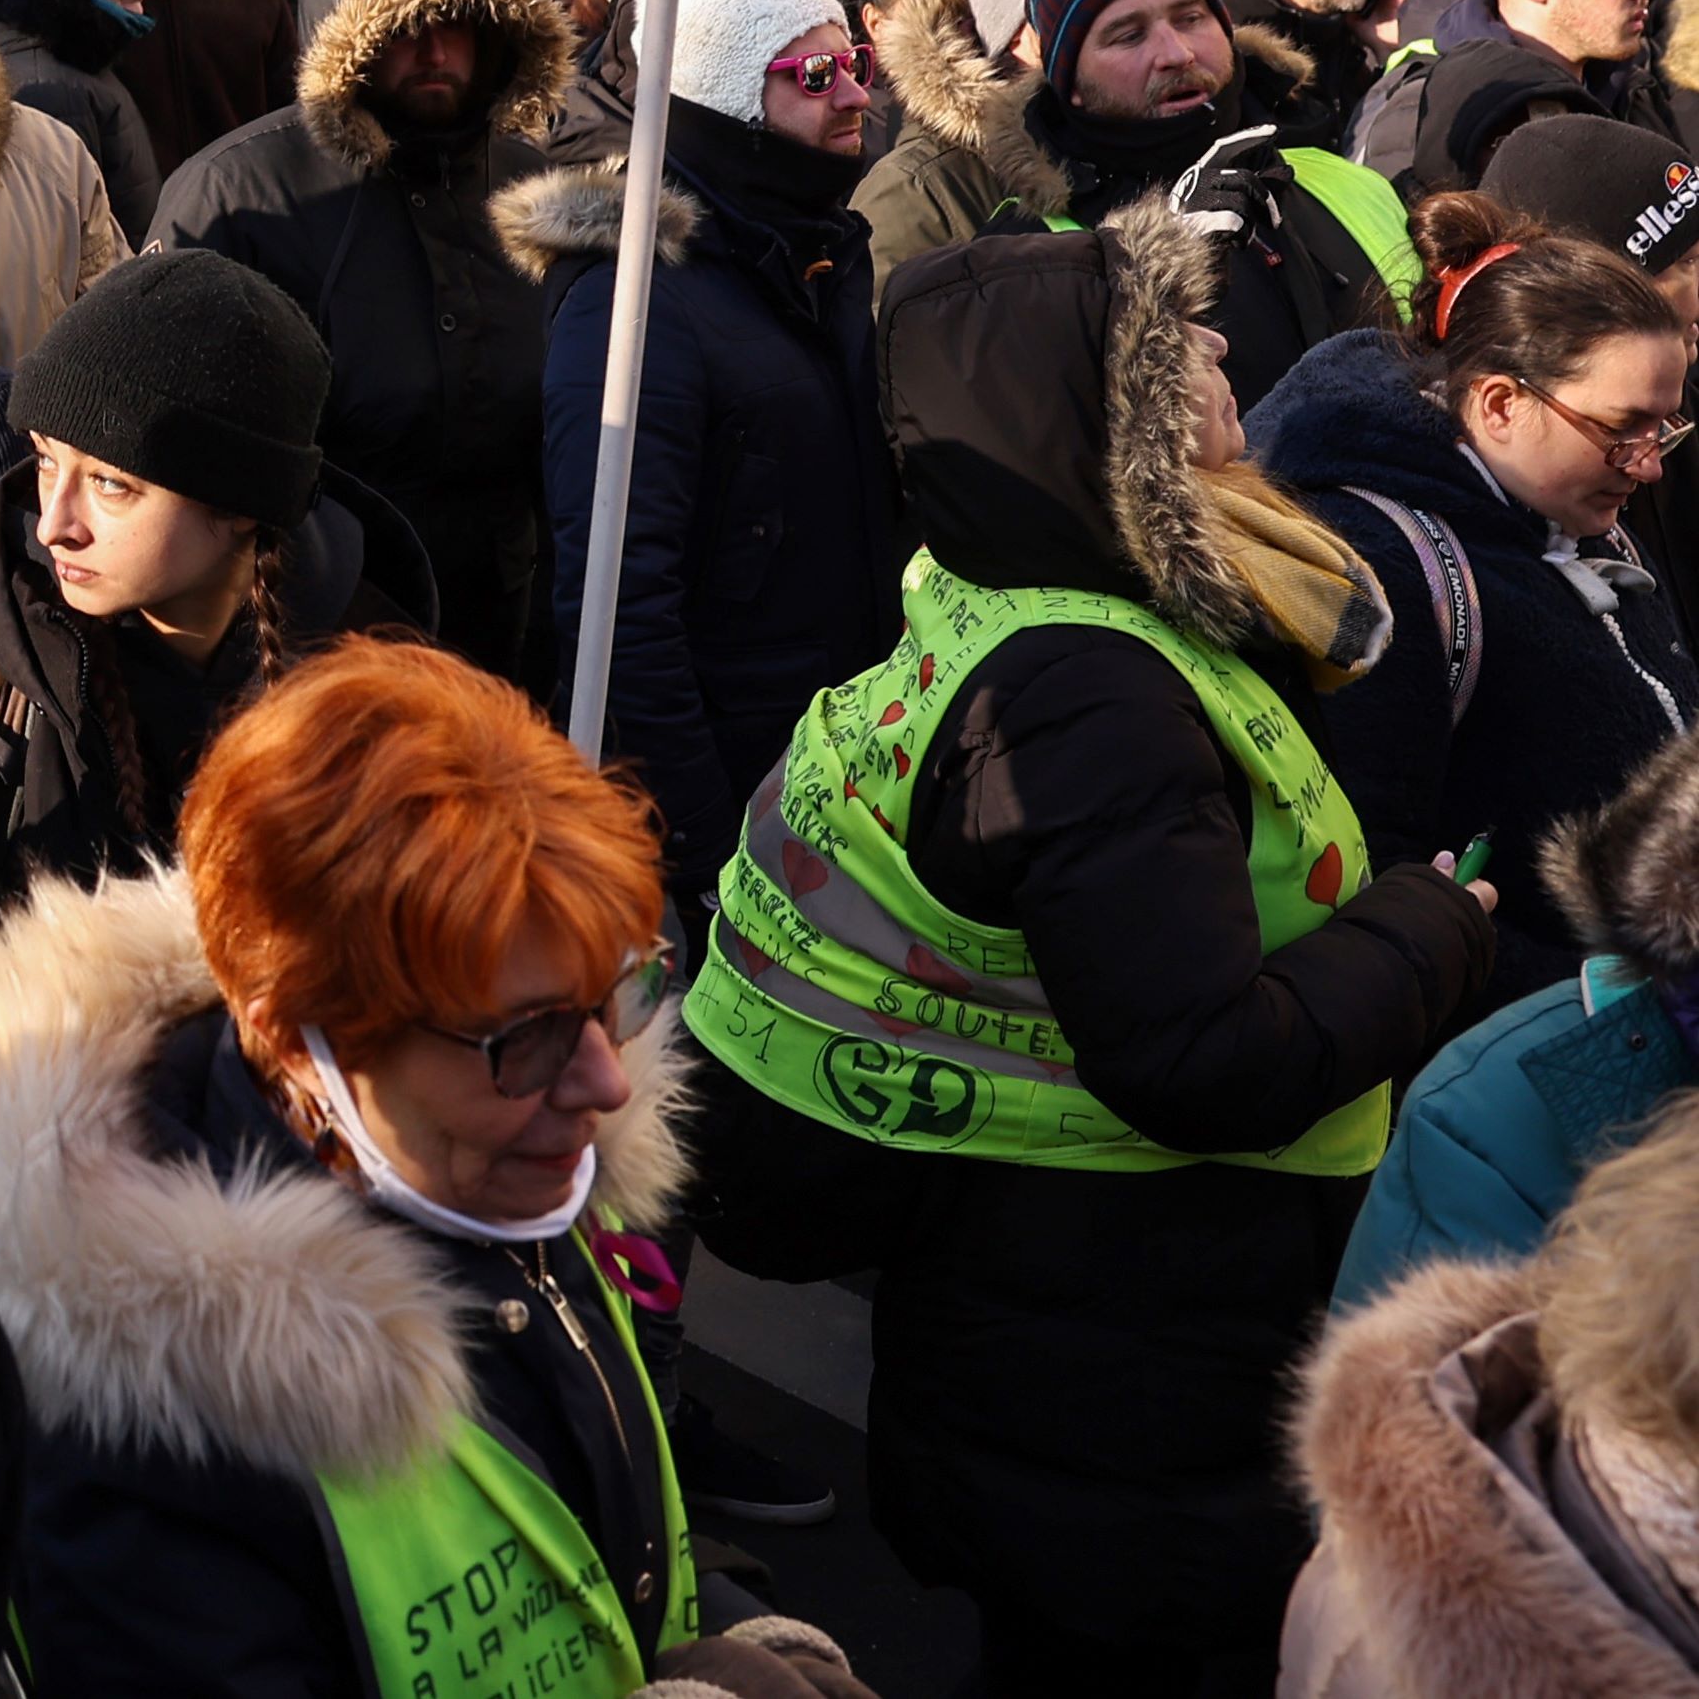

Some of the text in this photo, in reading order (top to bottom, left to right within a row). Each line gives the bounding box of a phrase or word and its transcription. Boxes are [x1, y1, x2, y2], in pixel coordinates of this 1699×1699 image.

[1626, 166, 1699, 266] elless
[1412, 508, 1443, 540] MISS
[1444, 558, 1466, 651] LEMONADE
[406, 1538, 519, 1656] STOP
[457, 1626, 503, 1681] LA
